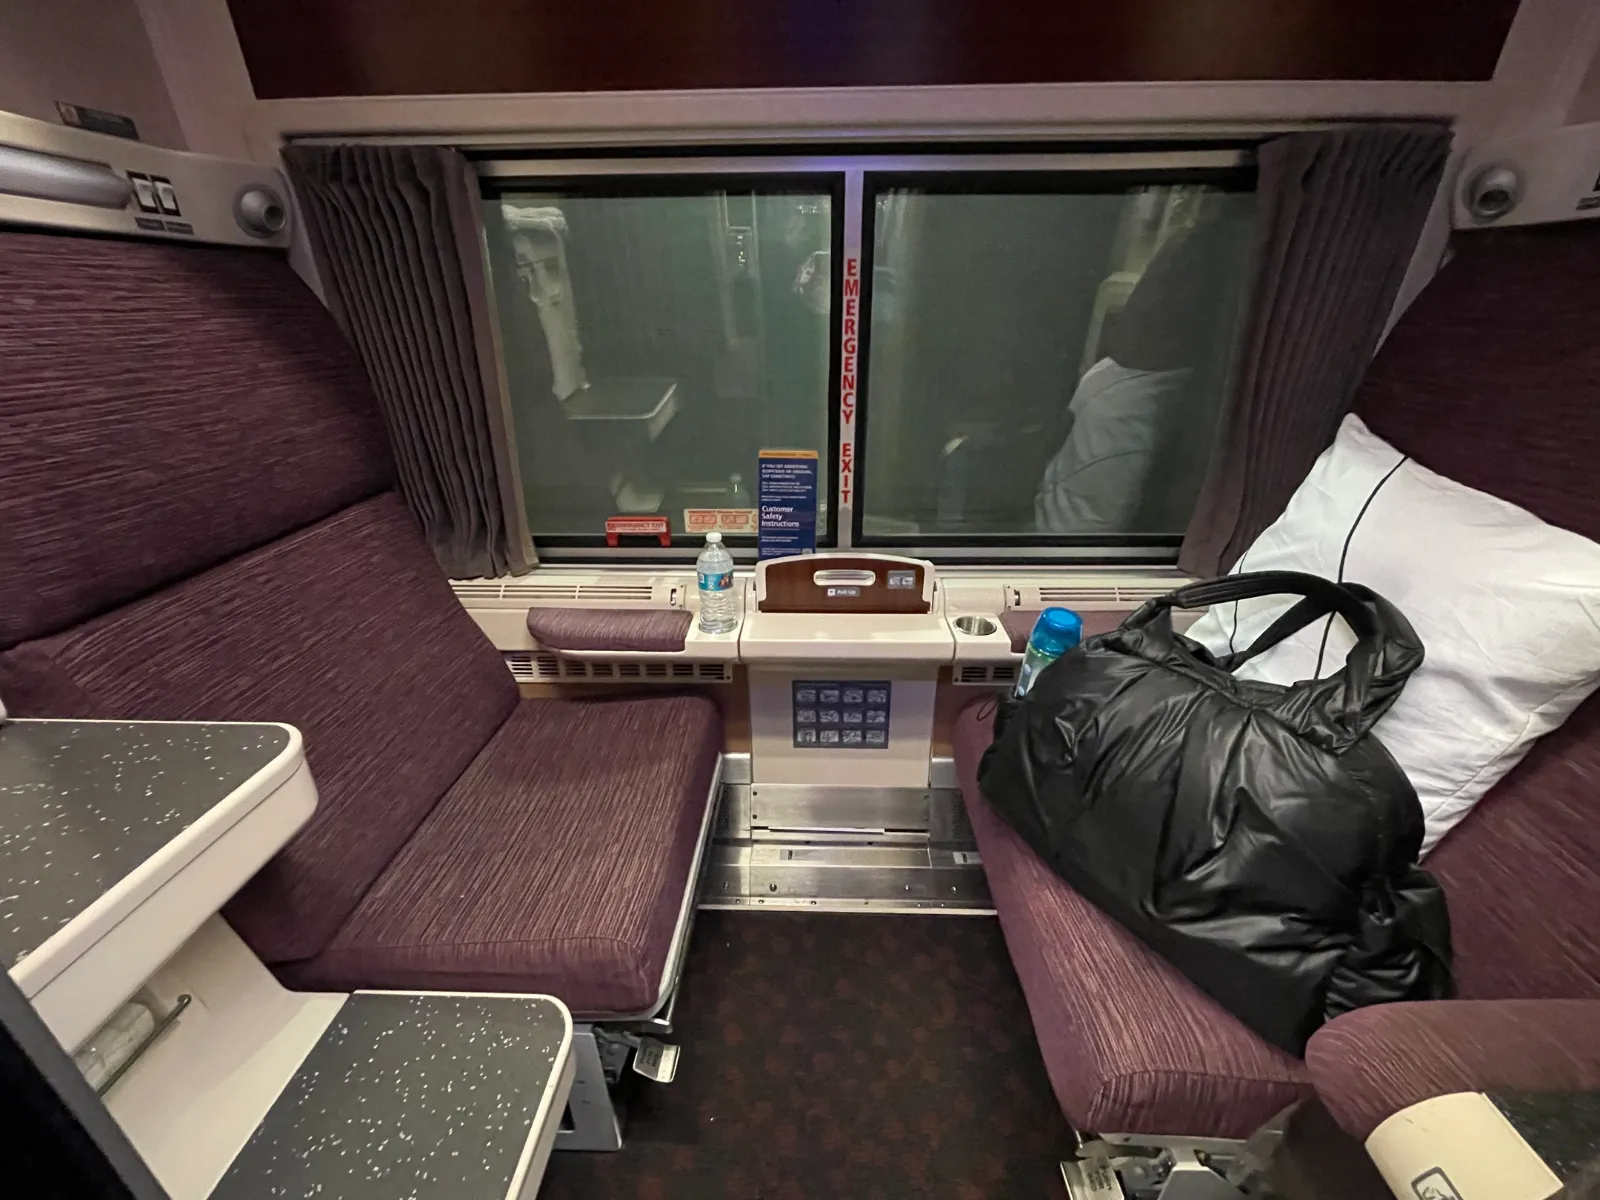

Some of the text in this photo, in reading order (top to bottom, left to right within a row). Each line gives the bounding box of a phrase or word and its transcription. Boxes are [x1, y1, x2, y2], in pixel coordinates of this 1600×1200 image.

[840, 258, 859, 503] EMERGENCY EXIT
[761, 513, 783, 521] Safety
[761, 520, 800, 528] Instructions
